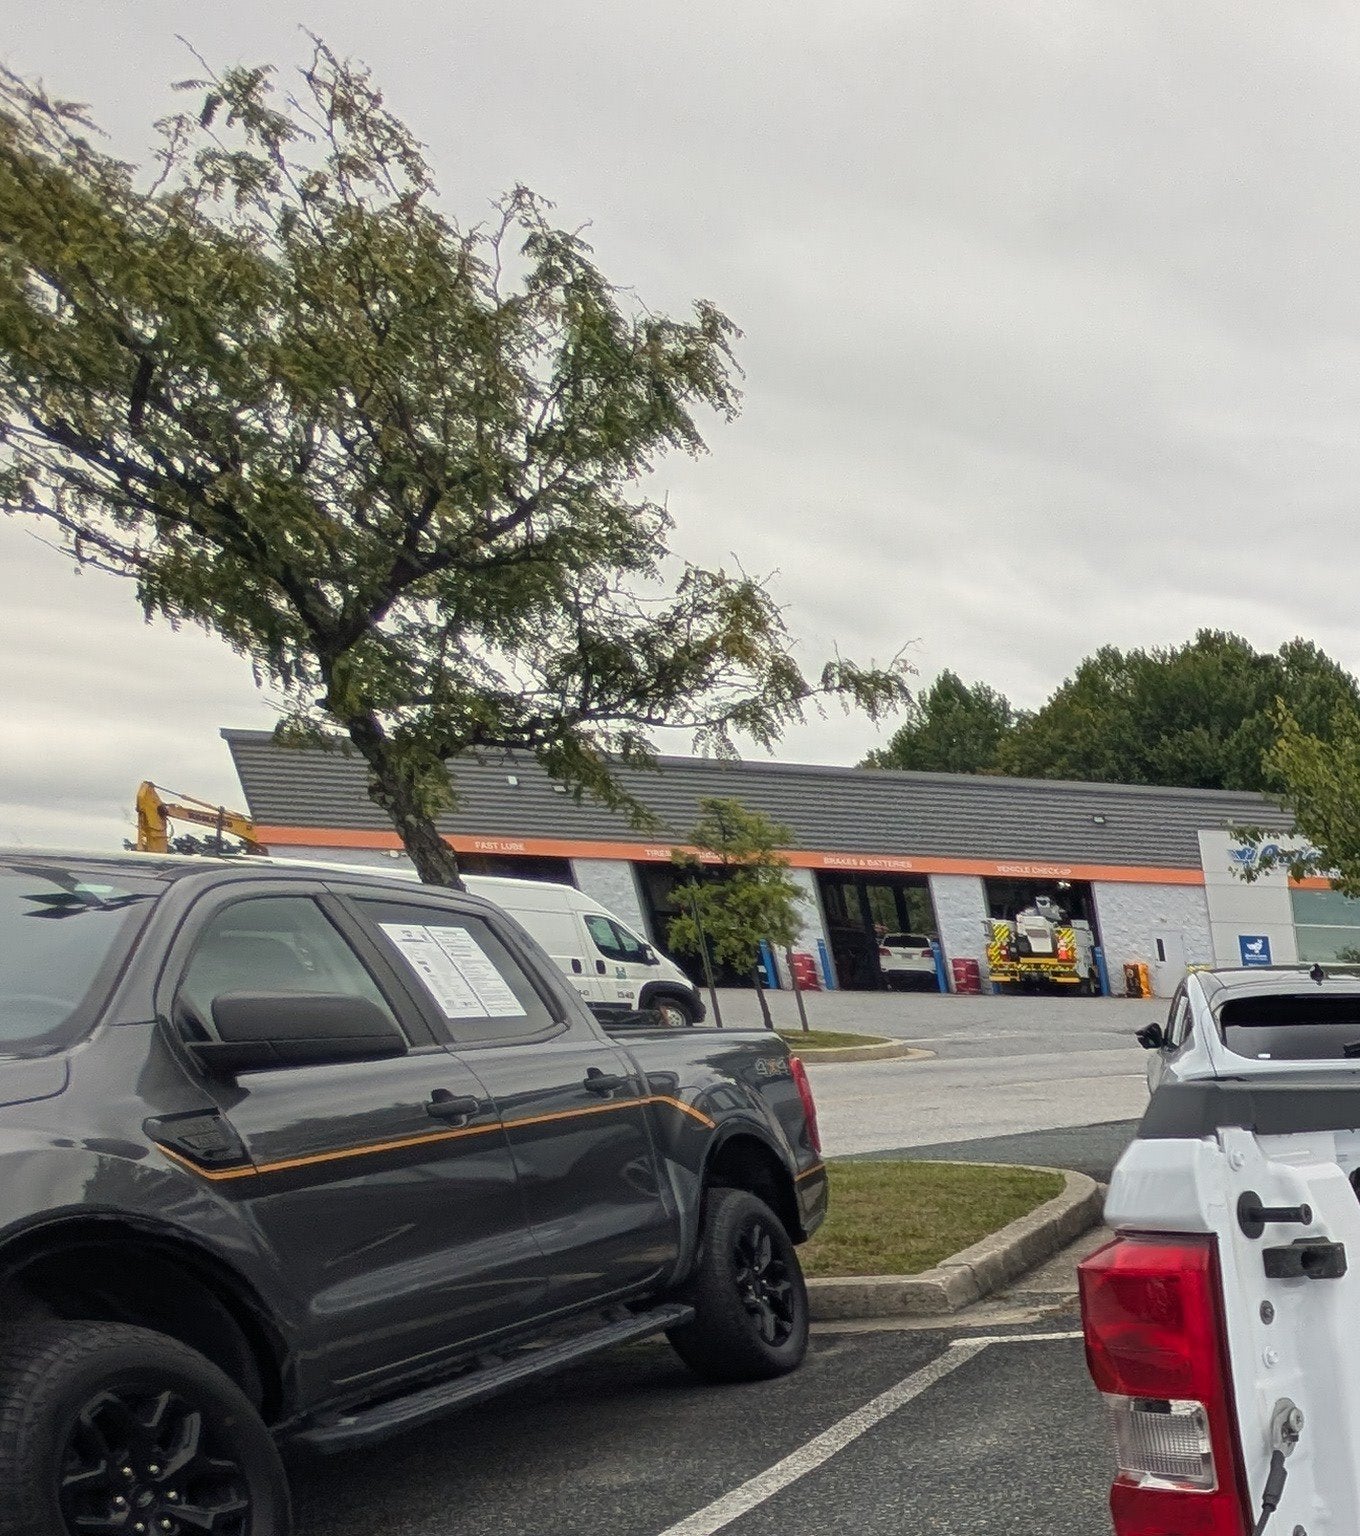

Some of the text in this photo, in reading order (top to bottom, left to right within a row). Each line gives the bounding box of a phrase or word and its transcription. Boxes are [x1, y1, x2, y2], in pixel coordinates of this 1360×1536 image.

[474, 841, 525, 851] FAST LUBE
[644, 848, 672, 857] TIRES
[823, 856, 857, 866] BRAKES
[867, 859, 913, 869] BATTERIES
[996, 865, 1030, 874] VEHICLE
